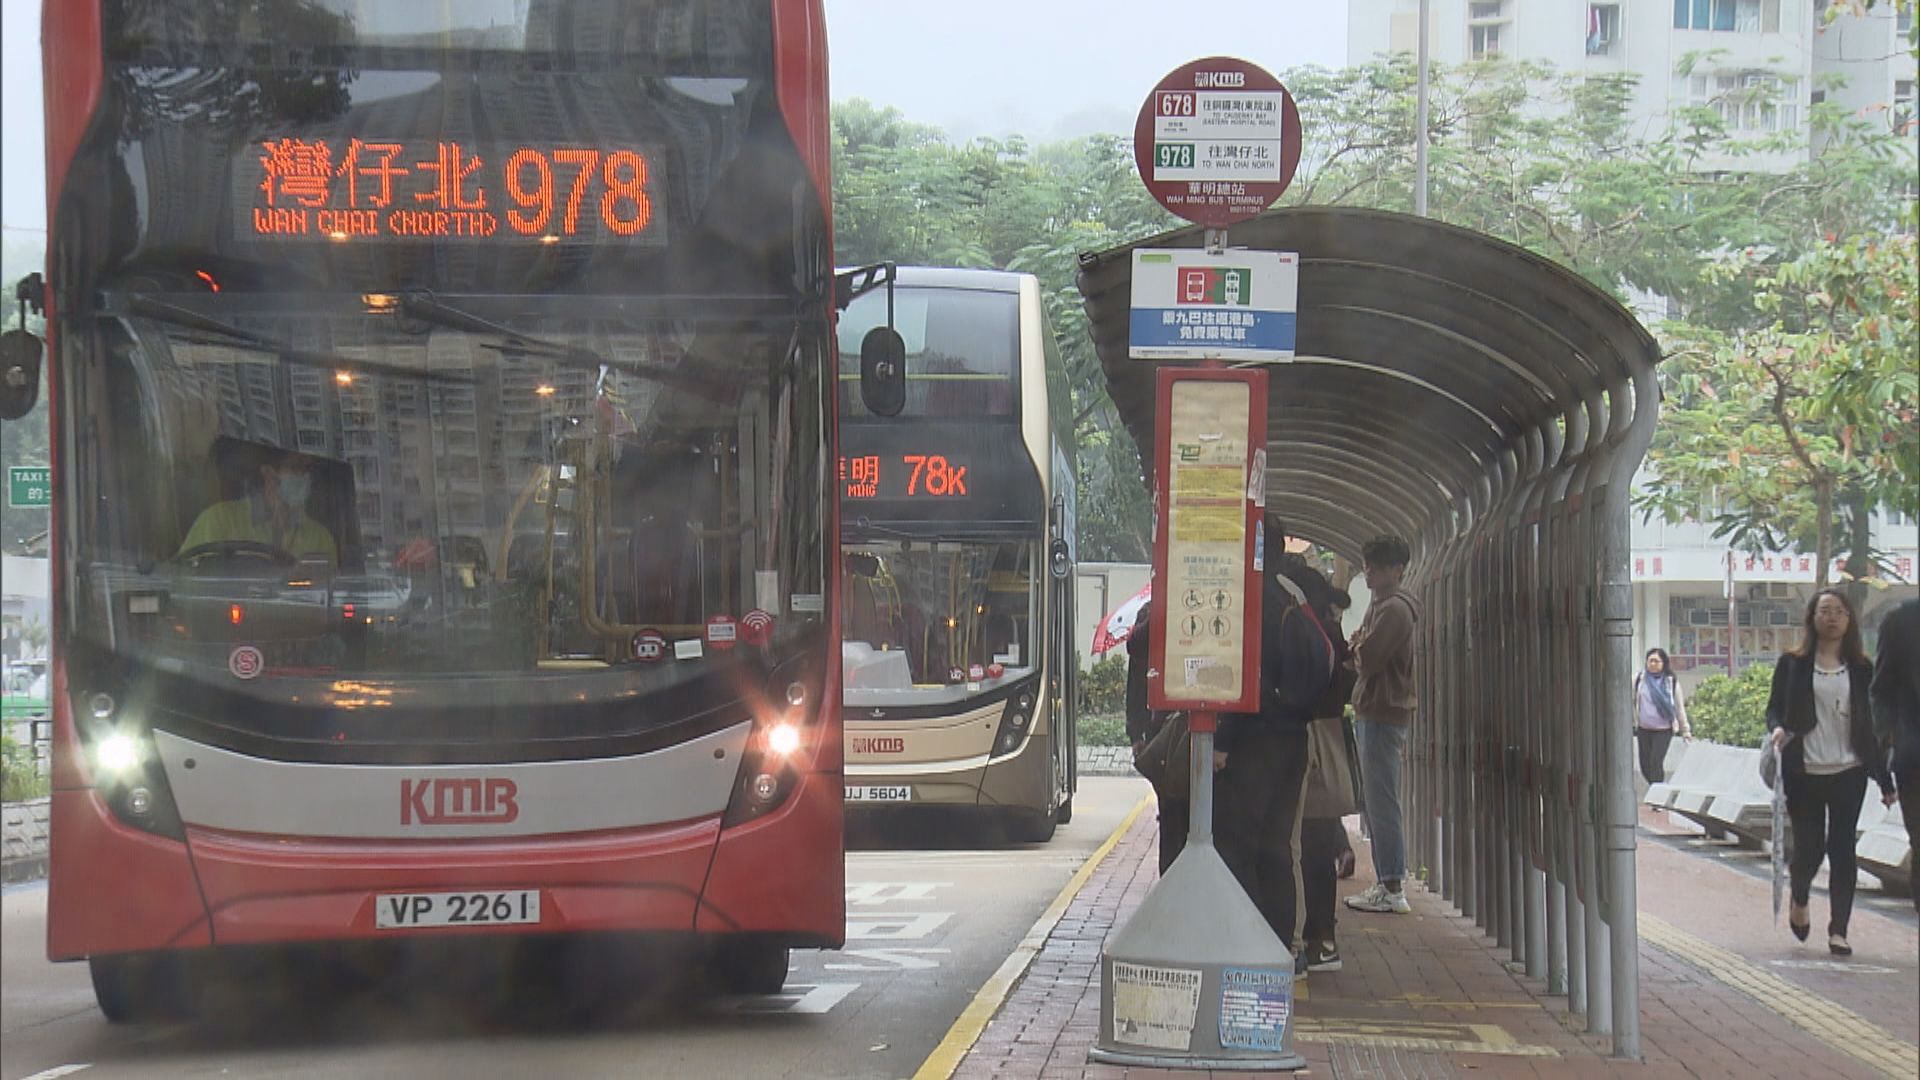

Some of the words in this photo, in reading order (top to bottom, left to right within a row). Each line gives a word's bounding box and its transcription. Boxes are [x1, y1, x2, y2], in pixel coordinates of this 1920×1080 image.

[1162, 94, 1192, 115] 678
[1161, 146, 1190, 166] 978
[1209, 144, 1268, 158] 往灣仔北
[259, 138, 487, 210] 灣仔北
[505, 148, 652, 236] 978
[1188, 182, 1246, 195] 華明總站
[1166, 196, 1184, 204] WAH
[1187, 196, 1206, 204] MING
[1208, 197, 1224, 205] BUS
[1227, 197, 1264, 205] TERMINUS
[253, 209, 307, 234] WAN
[317, 209, 378, 235] CHAI
[15, 472, 42, 481] TAXI
[847, 484, 876, 497] MING
[401, 777, 519, 825] KMB
[869, 788, 907, 799] 5604
[390, 896, 433, 924] VP
[447, 893, 527, 923] 2261
